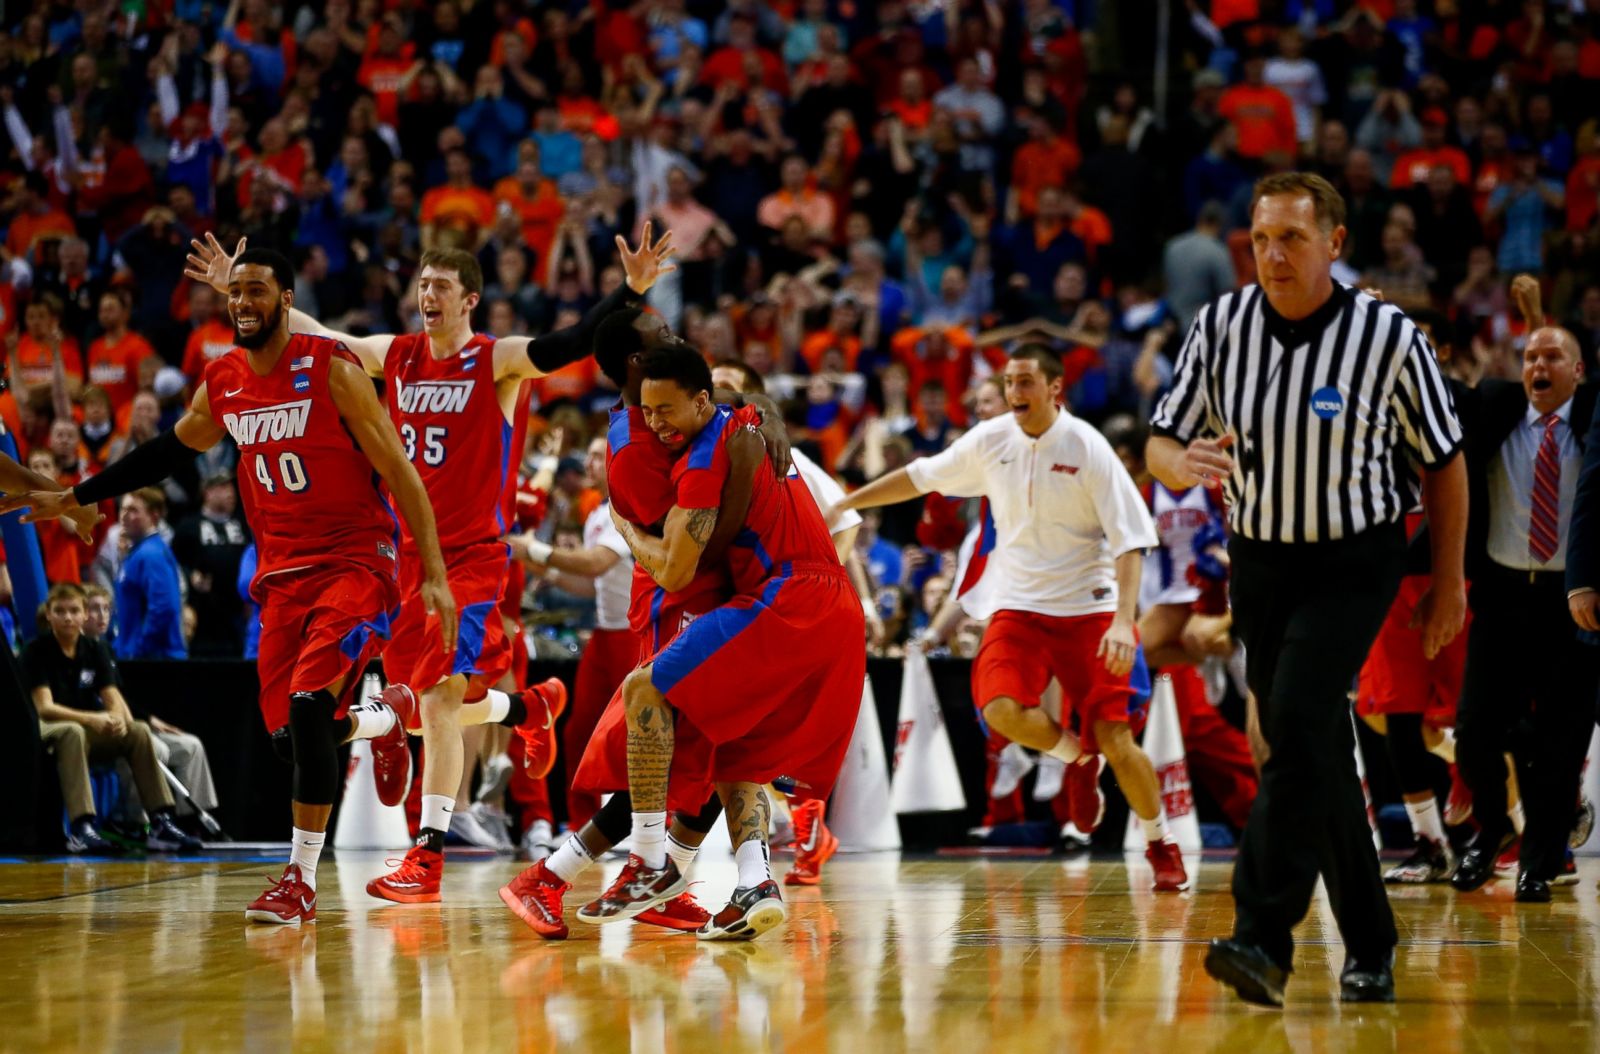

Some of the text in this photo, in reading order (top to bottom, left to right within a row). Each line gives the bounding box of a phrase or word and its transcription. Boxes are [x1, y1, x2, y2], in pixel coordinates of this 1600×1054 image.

[223, 399, 312, 446] DAYTON
[1314, 401, 1344, 412] NCAA
[401, 423, 447, 467] 35
[255, 452, 310, 493] 40
